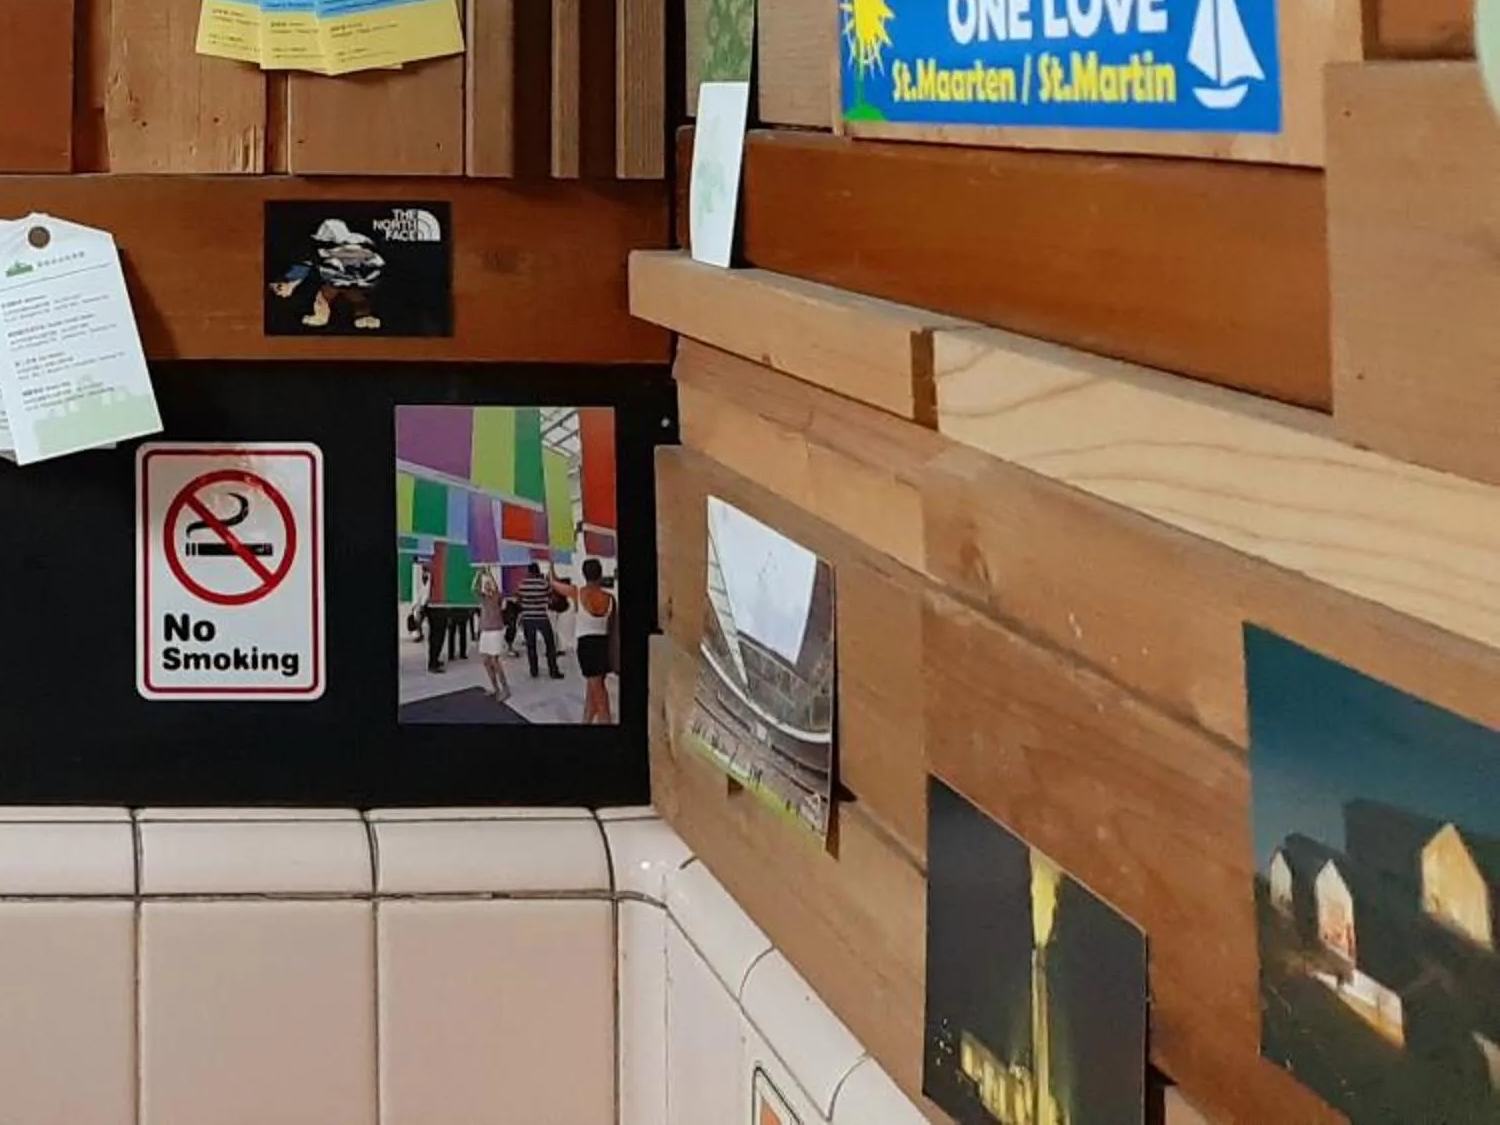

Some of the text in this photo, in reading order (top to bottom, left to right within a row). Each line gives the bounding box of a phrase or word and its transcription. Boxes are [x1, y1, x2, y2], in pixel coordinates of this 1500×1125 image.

[891, 57, 1016, 104] St.Maarten
[1038, 50, 1177, 103] St.Martin
[373, 219, 417, 231] NORTH
[392, 209, 417, 220] THE
[385, 230, 417, 242] FACE
[163, 613, 216, 643] No
[162, 647, 299, 677] Smoking
